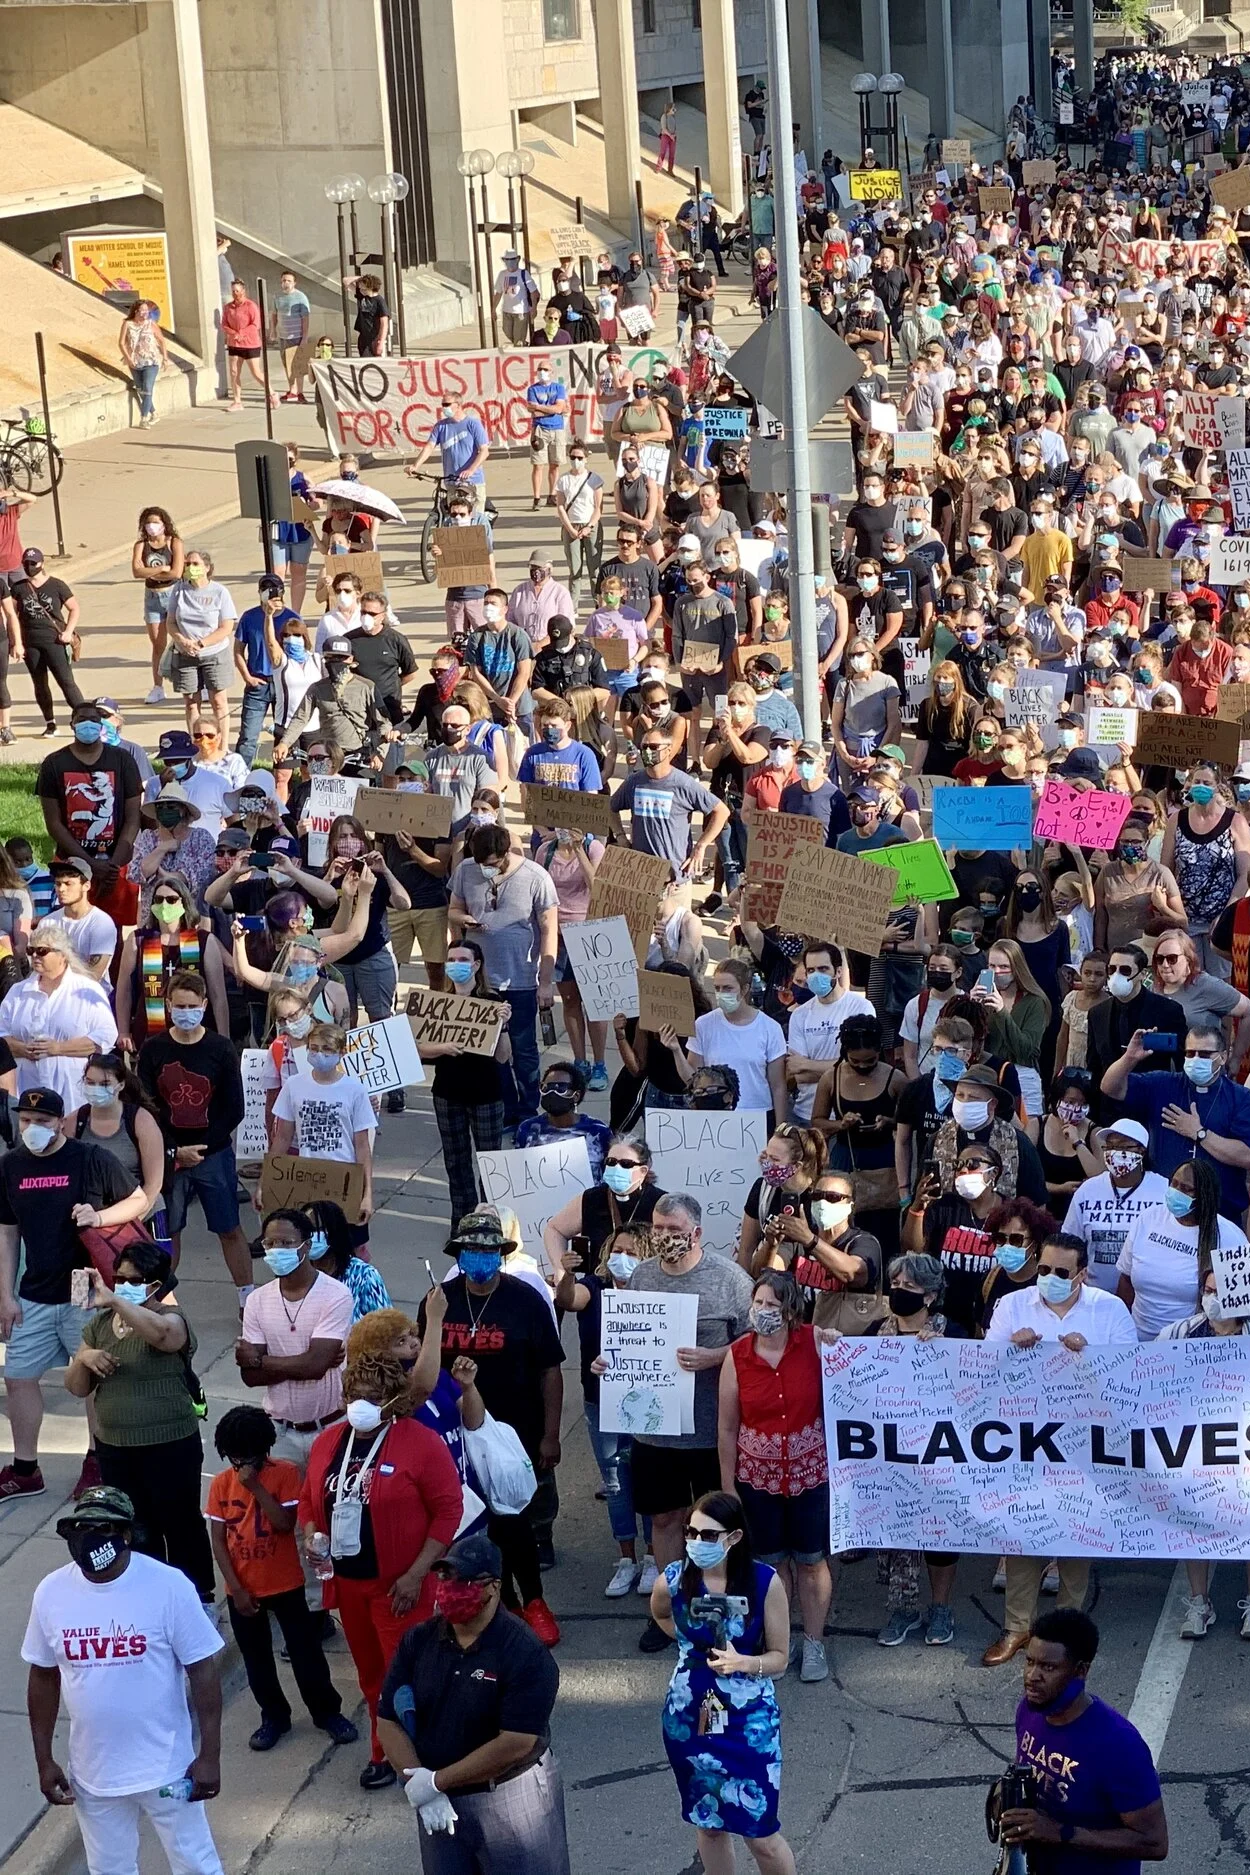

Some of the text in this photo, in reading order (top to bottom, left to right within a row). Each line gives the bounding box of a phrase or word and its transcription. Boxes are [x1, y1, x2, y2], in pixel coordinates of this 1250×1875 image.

[327, 363, 389, 402] NO
[704, 410, 742, 419] JUSTICE
[1185, 395, 1219, 416] ALLY
[337, 410, 396, 449] FOR
[1188, 430, 1223, 448] VERB
[1223, 559, 1250, 573] 1619
[1010, 689, 1043, 704] BLACK
[1009, 712, 1048, 725] MATTER
[1019, 704, 1042, 713] LIVES
[1046, 782, 1124, 818] Be Equal
[752, 813, 822, 837] INJUSTICE
[1074, 822, 1116, 847] Racist
[581, 932, 612, 961] NO
[573, 958, 638, 986] JUSTICE
[598, 983, 621, 998] NO
[406, 992, 500, 1026] BLACK LIVES
[593, 995, 639, 1015] PEACE
[416, 1019, 487, 1049] MATTER!
[647, 1111, 759, 1157] BLACK
[269, 1158, 328, 1184] Silence
[478, 1150, 586, 1201] BLACK
[18, 1174, 70, 1190] JUXTAPOZ
[1231, 1260, 1245, 1272] to
[1224, 1275, 1238, 1293] is
[603, 1294, 666, 1315] INJUSTICE
[1221, 1290, 1250, 1310] than
[606, 1320, 652, 1334] anywhere
[618, 1336, 666, 1346] threat to
[824, 1340, 851, 1363] Keith
[604, 1348, 662, 1371] JUSTICE
[825, 1343, 868, 1378] Childress
[1184, 1350, 1248, 1368] Stallworth
[848, 1368, 890, 1388] Matthews
[1100, 1391, 1139, 1413] Gregory
[836, 1420, 1067, 1465] BLACK
[960, 1464, 1006, 1475] Christian
[90, 1541, 113, 1559] BLACK
[94, 1552, 115, 1566] LIVES
[62, 1627, 100, 1638] VALUE
[63, 1634, 147, 1661] LIVES
[1020, 1730, 1079, 1783] BLACK
